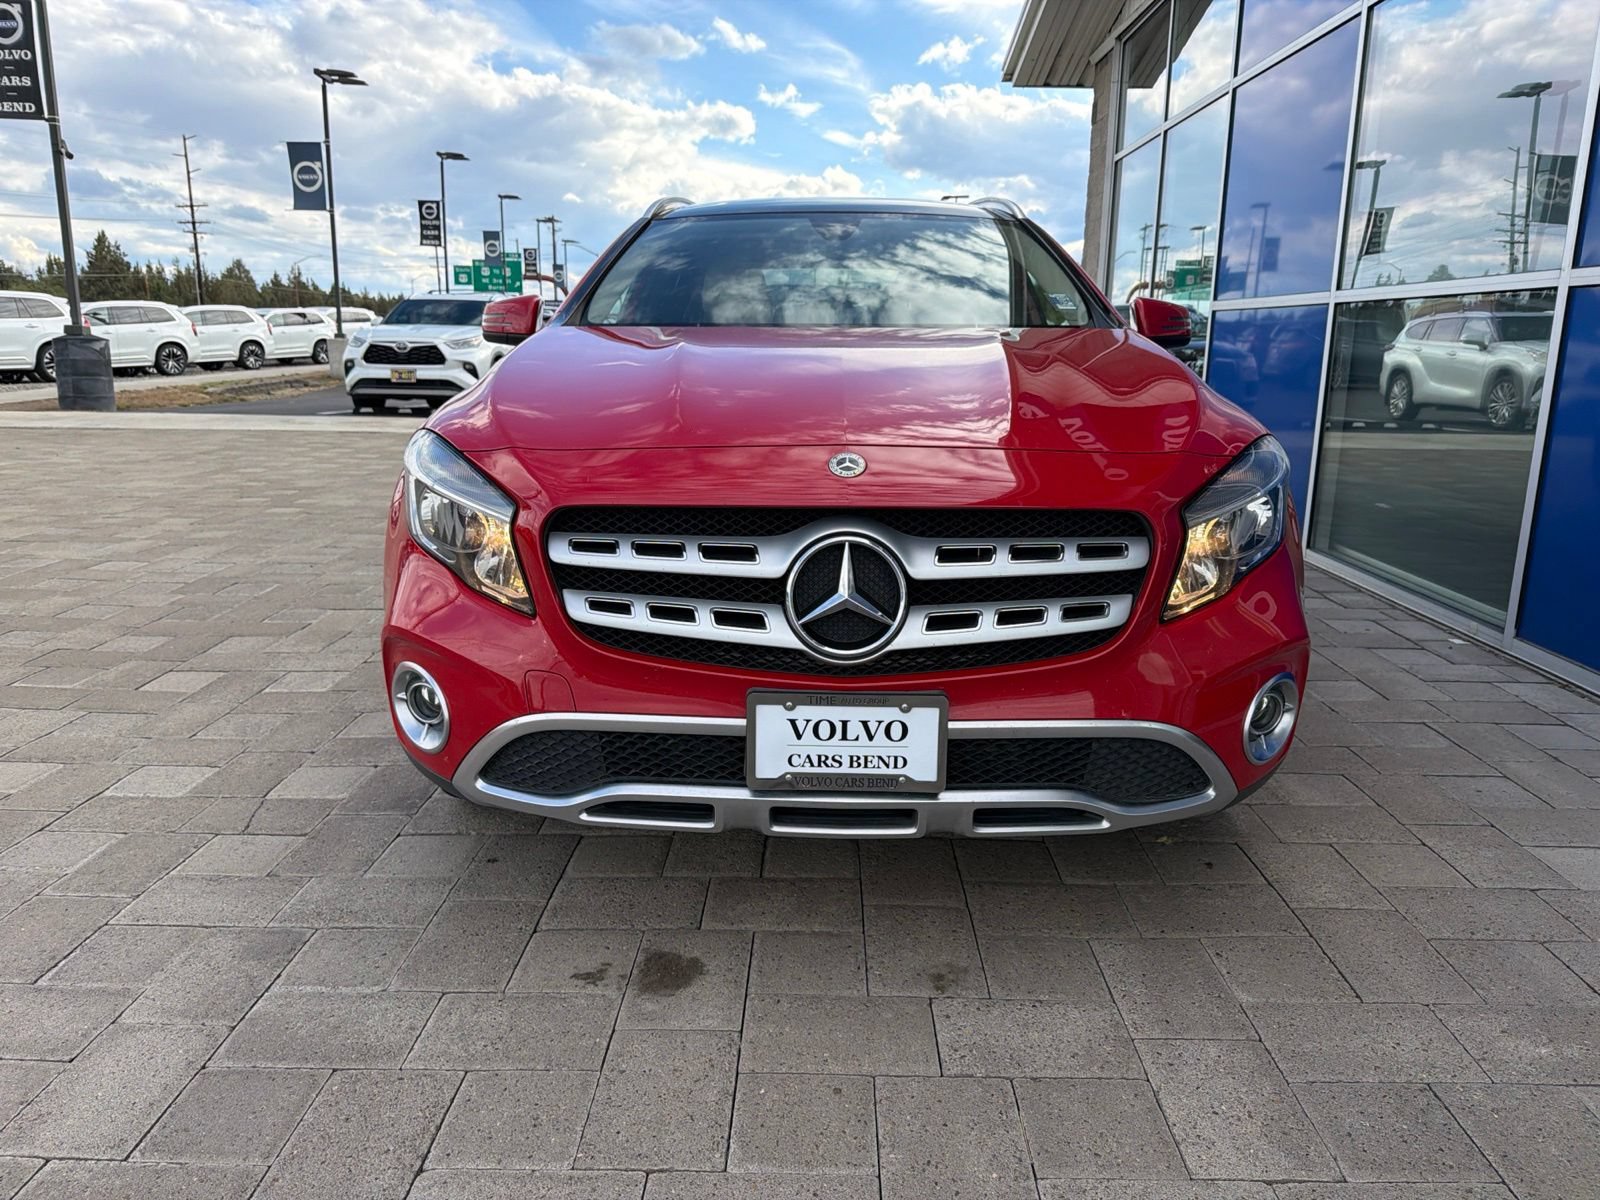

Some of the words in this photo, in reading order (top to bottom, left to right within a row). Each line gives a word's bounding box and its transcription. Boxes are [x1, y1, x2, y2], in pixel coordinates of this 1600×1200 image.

[0, 75, 31, 86] ARS
[0, 102, 36, 113] END
[807, 695, 837, 705] TIME
[786, 718, 909, 742] VOLVO
[787, 753, 843, 769] CARS
[848, 755, 908, 770] BEND
[794, 776, 833, 788] VOLVO
[835, 777, 865, 789] CARS
[867, 778, 898, 790] BEND
